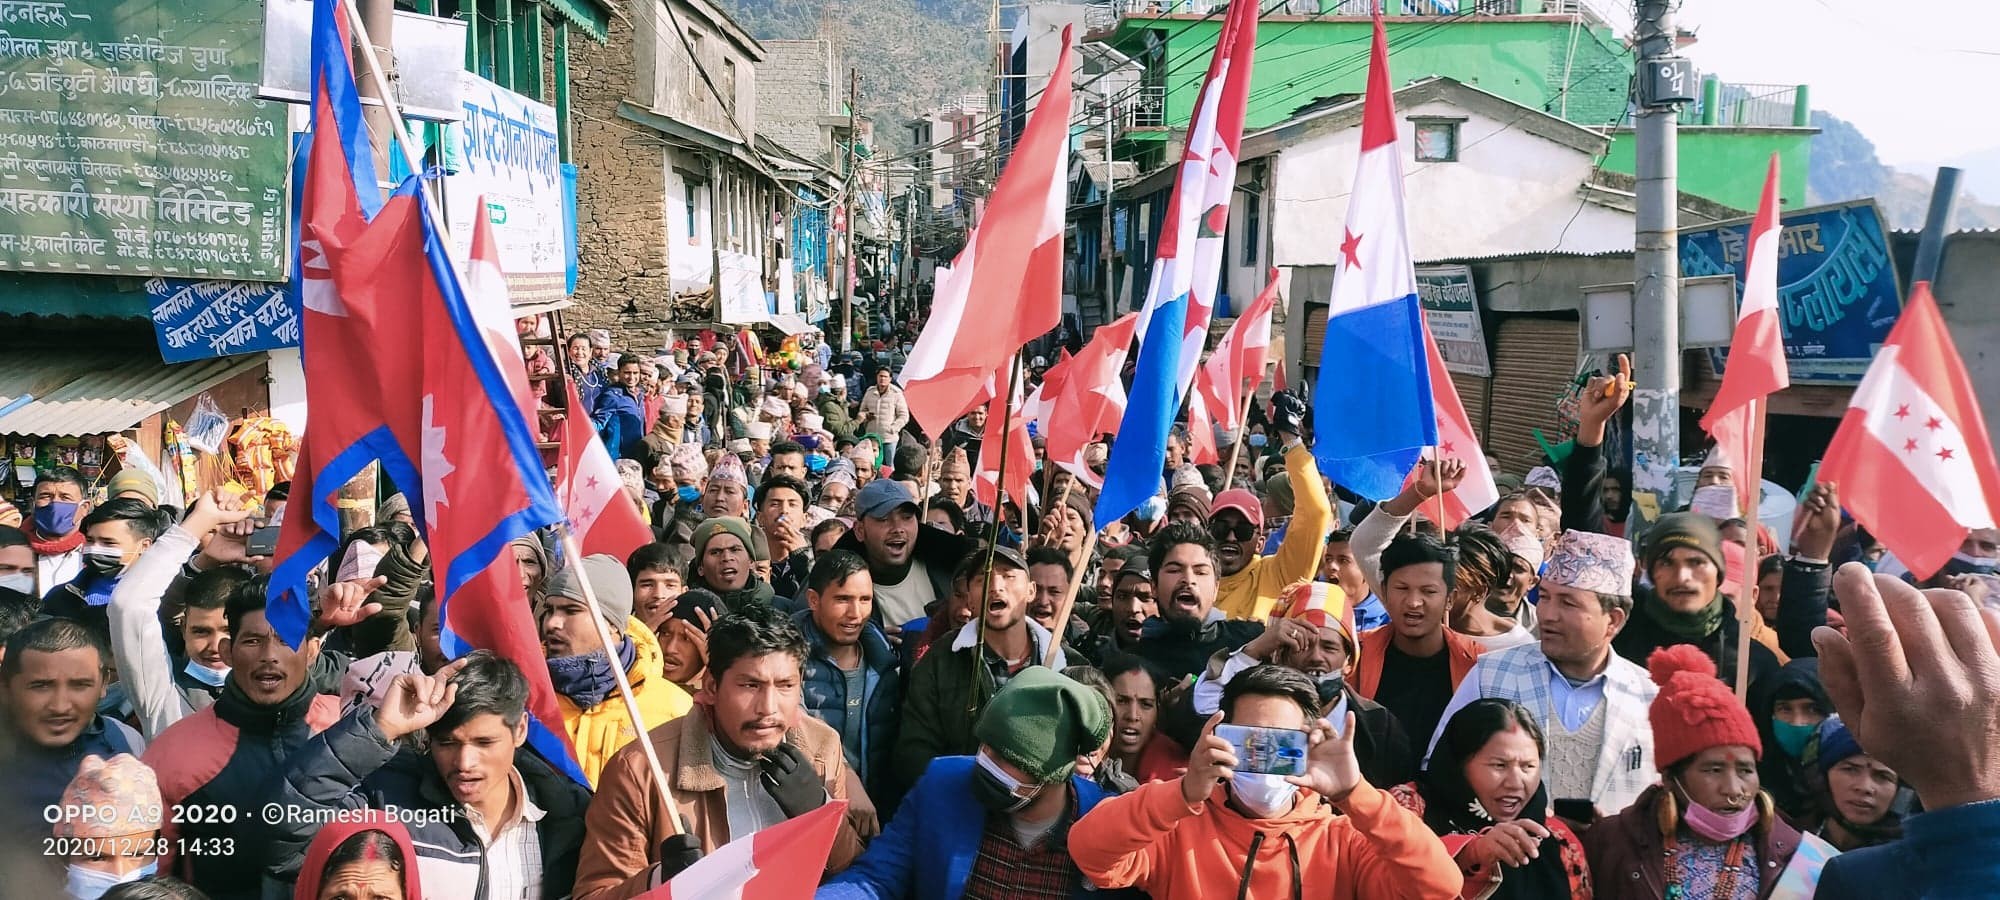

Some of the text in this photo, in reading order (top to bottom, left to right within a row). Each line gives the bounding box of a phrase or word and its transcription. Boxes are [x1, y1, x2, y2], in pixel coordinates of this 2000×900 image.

[0, 183, 90, 219] सहकारी
[91, 187, 151, 221] संस्था
[152, 187, 254, 226] लिमिटेड
